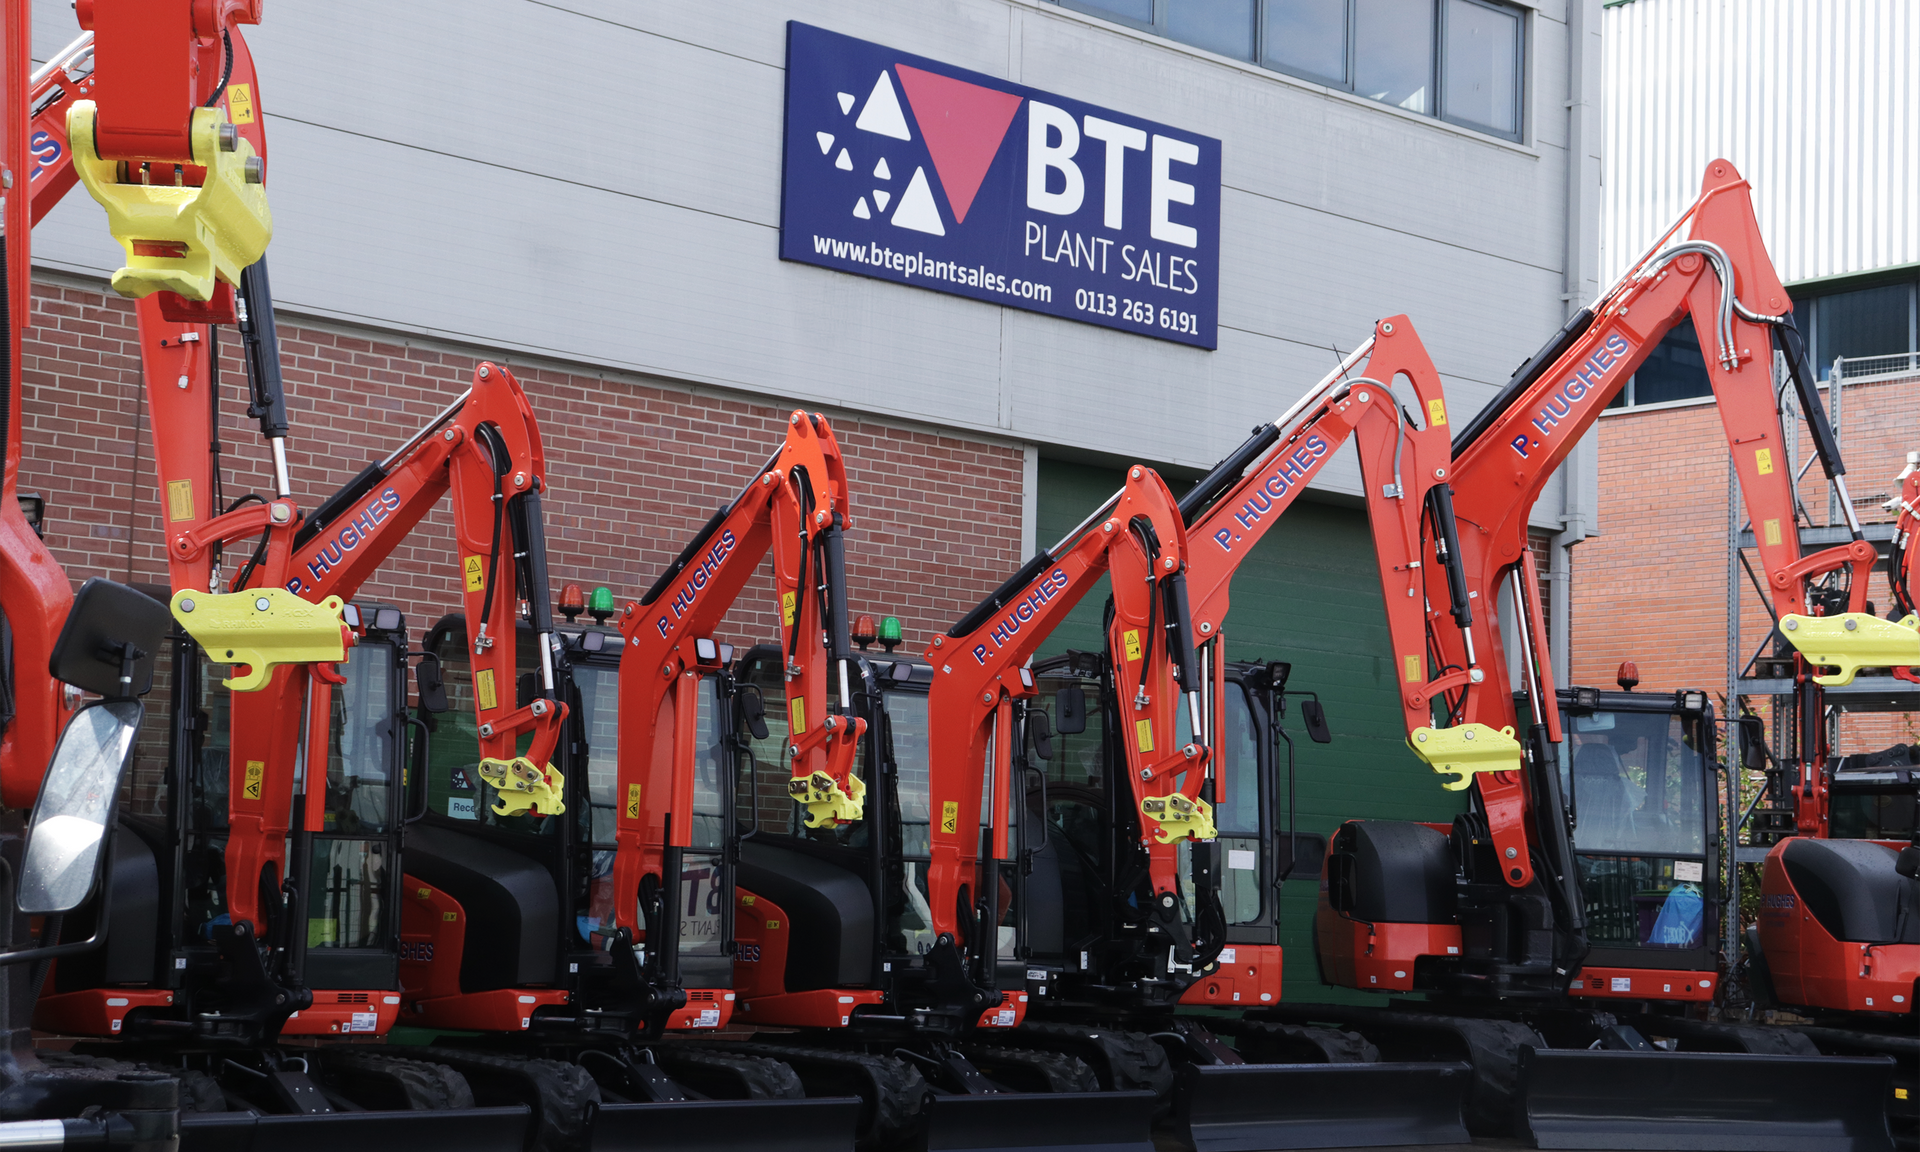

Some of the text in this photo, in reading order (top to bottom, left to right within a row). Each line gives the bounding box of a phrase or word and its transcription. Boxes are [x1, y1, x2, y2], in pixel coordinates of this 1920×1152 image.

[1027, 100, 1199, 248] BTE
[813, 235, 1051, 303] www.bteplantsales.com
[1025, 221, 1198, 294] PLANT SALES
[1075, 288, 1198, 335] 0113 263 6191
[1510, 334, 1629, 459] P. HUGHES
[1213, 435, 1328, 552] P. HUGHES
[286, 487, 401, 595] P. HUGHES
[222, 619, 265, 629] RHINOX
[656, 529, 736, 639] P. HUGHES
[972, 568, 1068, 666] P. HUGHES
[1766, 894, 1795, 909] HUGHES
[400, 941, 434, 962] GHES
